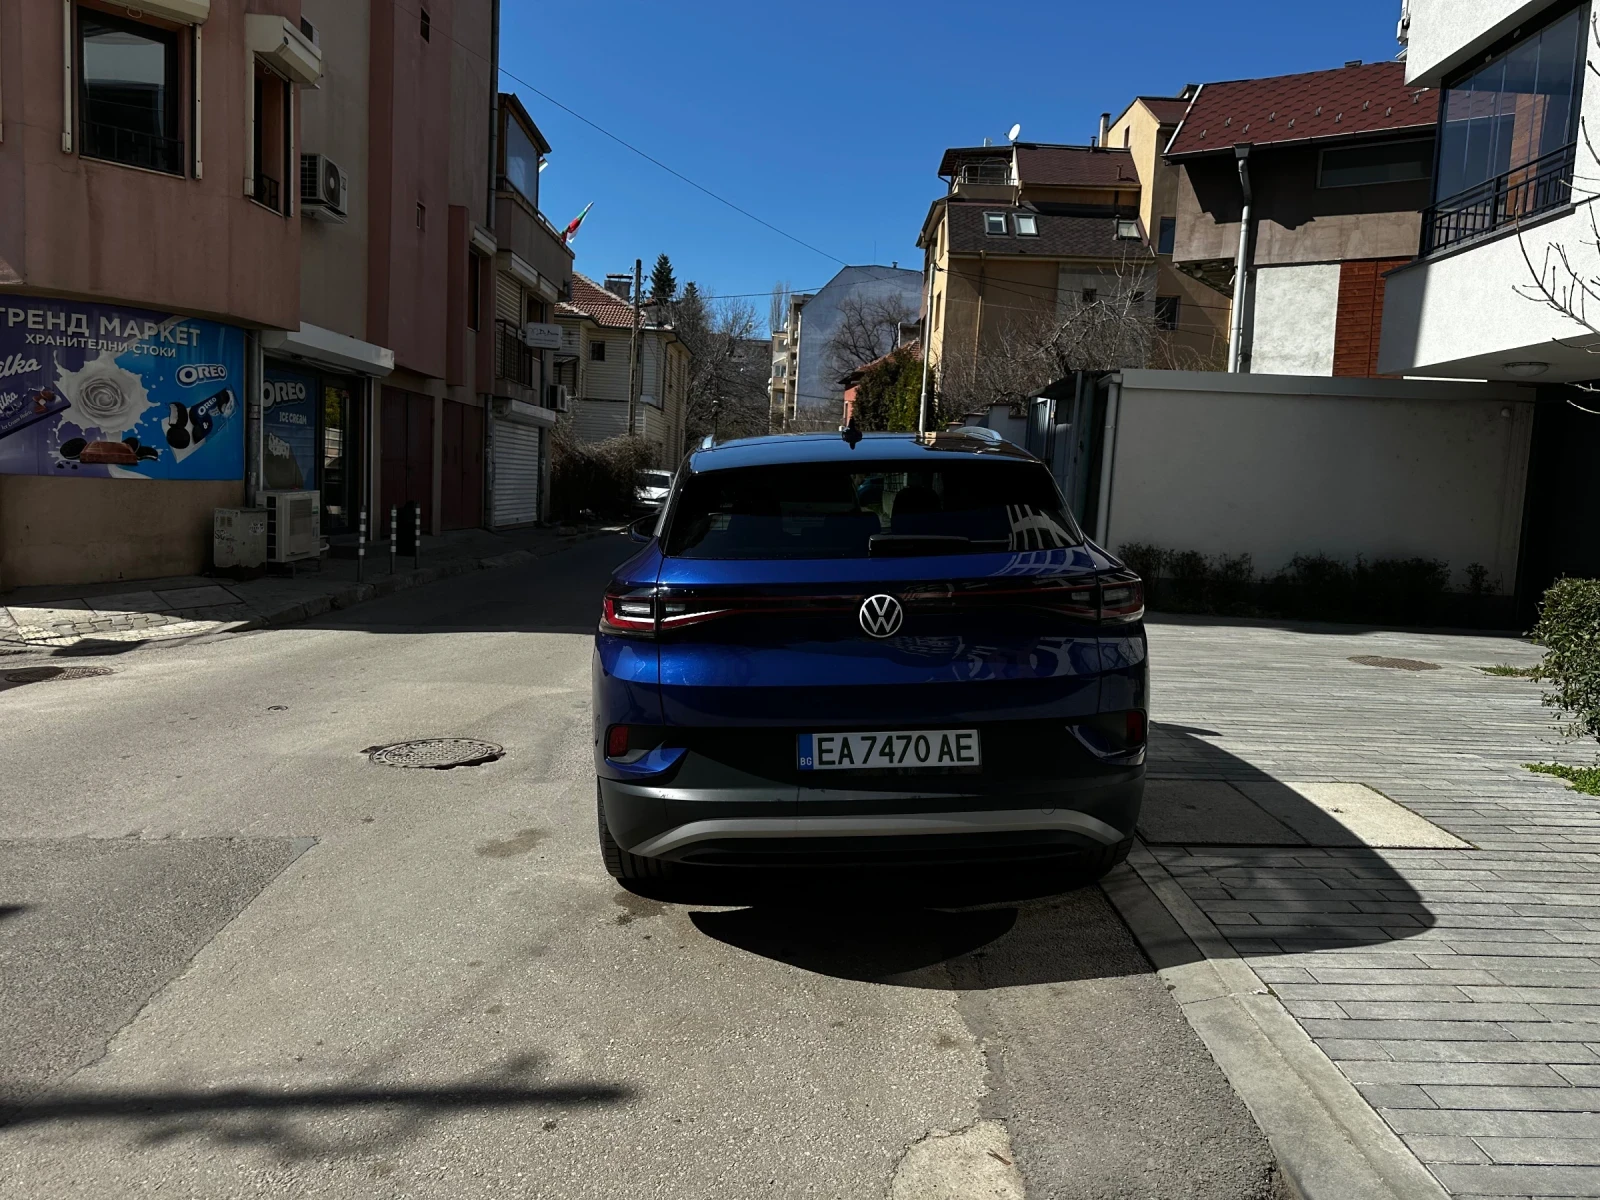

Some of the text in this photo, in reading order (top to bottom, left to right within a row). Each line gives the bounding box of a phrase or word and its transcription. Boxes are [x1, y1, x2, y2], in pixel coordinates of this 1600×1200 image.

[100, 316, 201, 347] МАРКЕТ
[25, 333, 176, 358] ХРАНИТЕЛНИ СТОКИ
[178, 366, 226, 384] OREO
[263, 381, 306, 408] OREO
[198, 397, 217, 416] OREO
[279, 411, 308, 425] ICE CREAM
[817, 733, 975, 766] EA 7470 AE
[800, 757, 812, 766] BG
